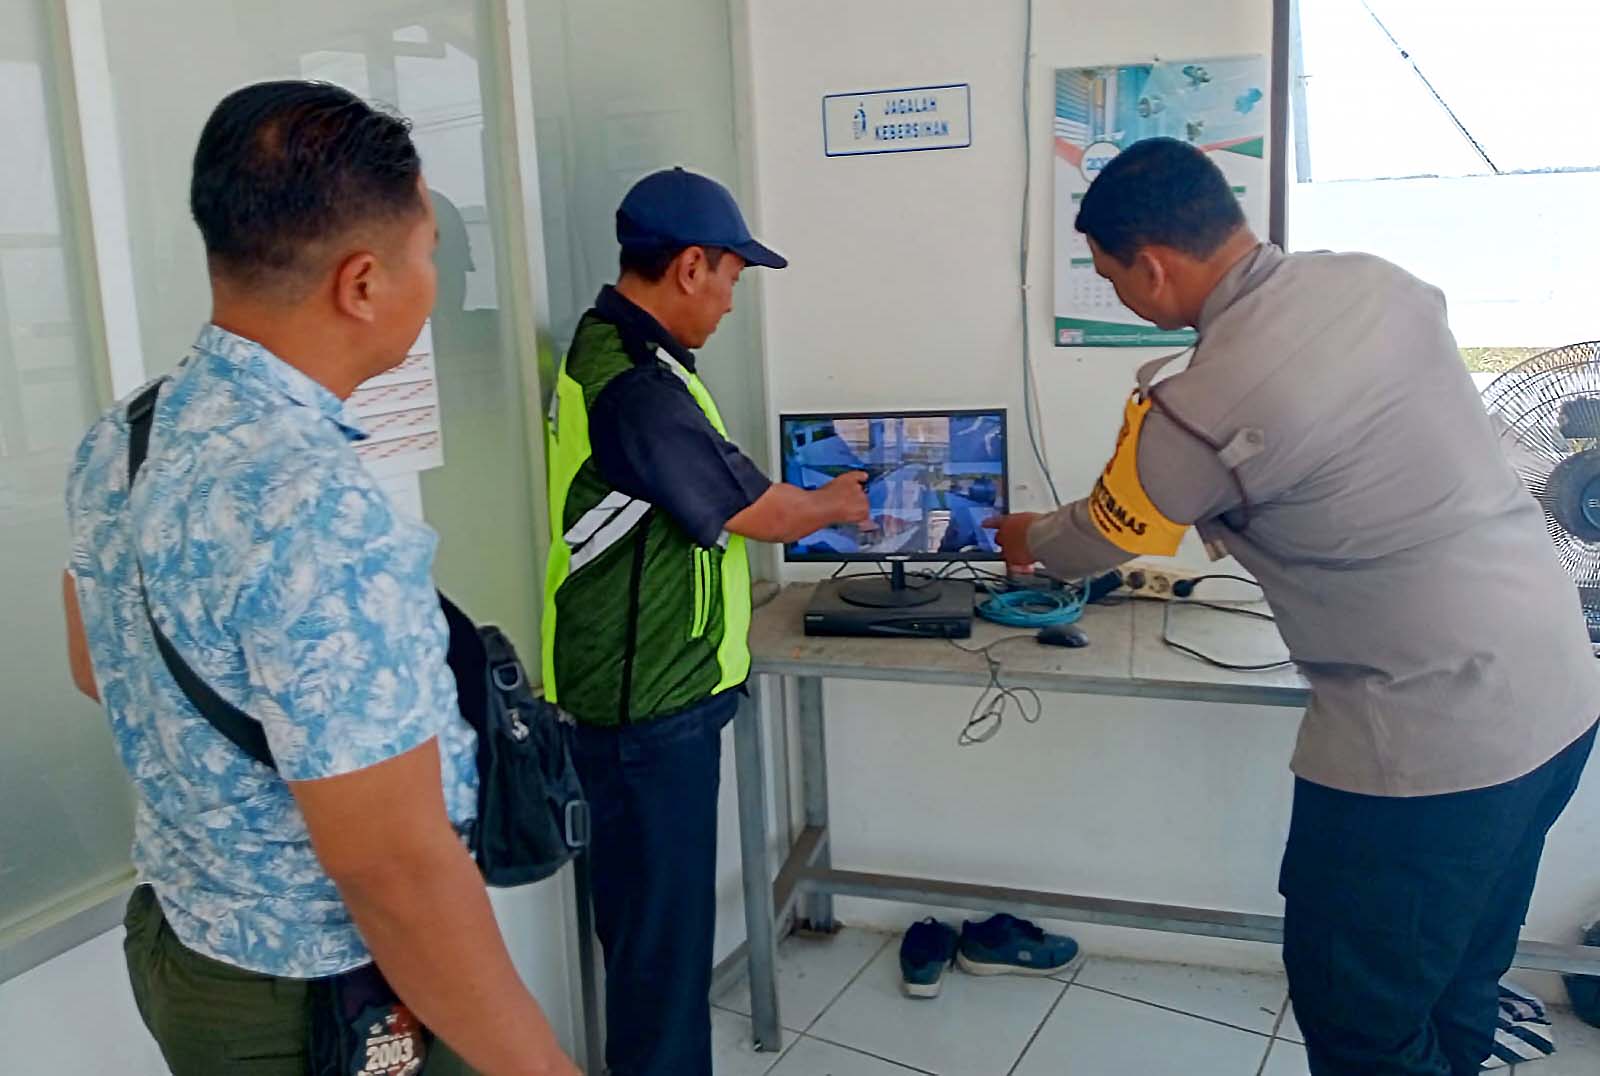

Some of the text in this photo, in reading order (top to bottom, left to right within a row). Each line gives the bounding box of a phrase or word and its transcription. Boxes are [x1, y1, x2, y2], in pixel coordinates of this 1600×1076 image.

[884, 96, 937, 115] JAGALAH
[874, 121, 949, 140] KEBERSIHAN
[365, 1037, 414, 1071] 2003
